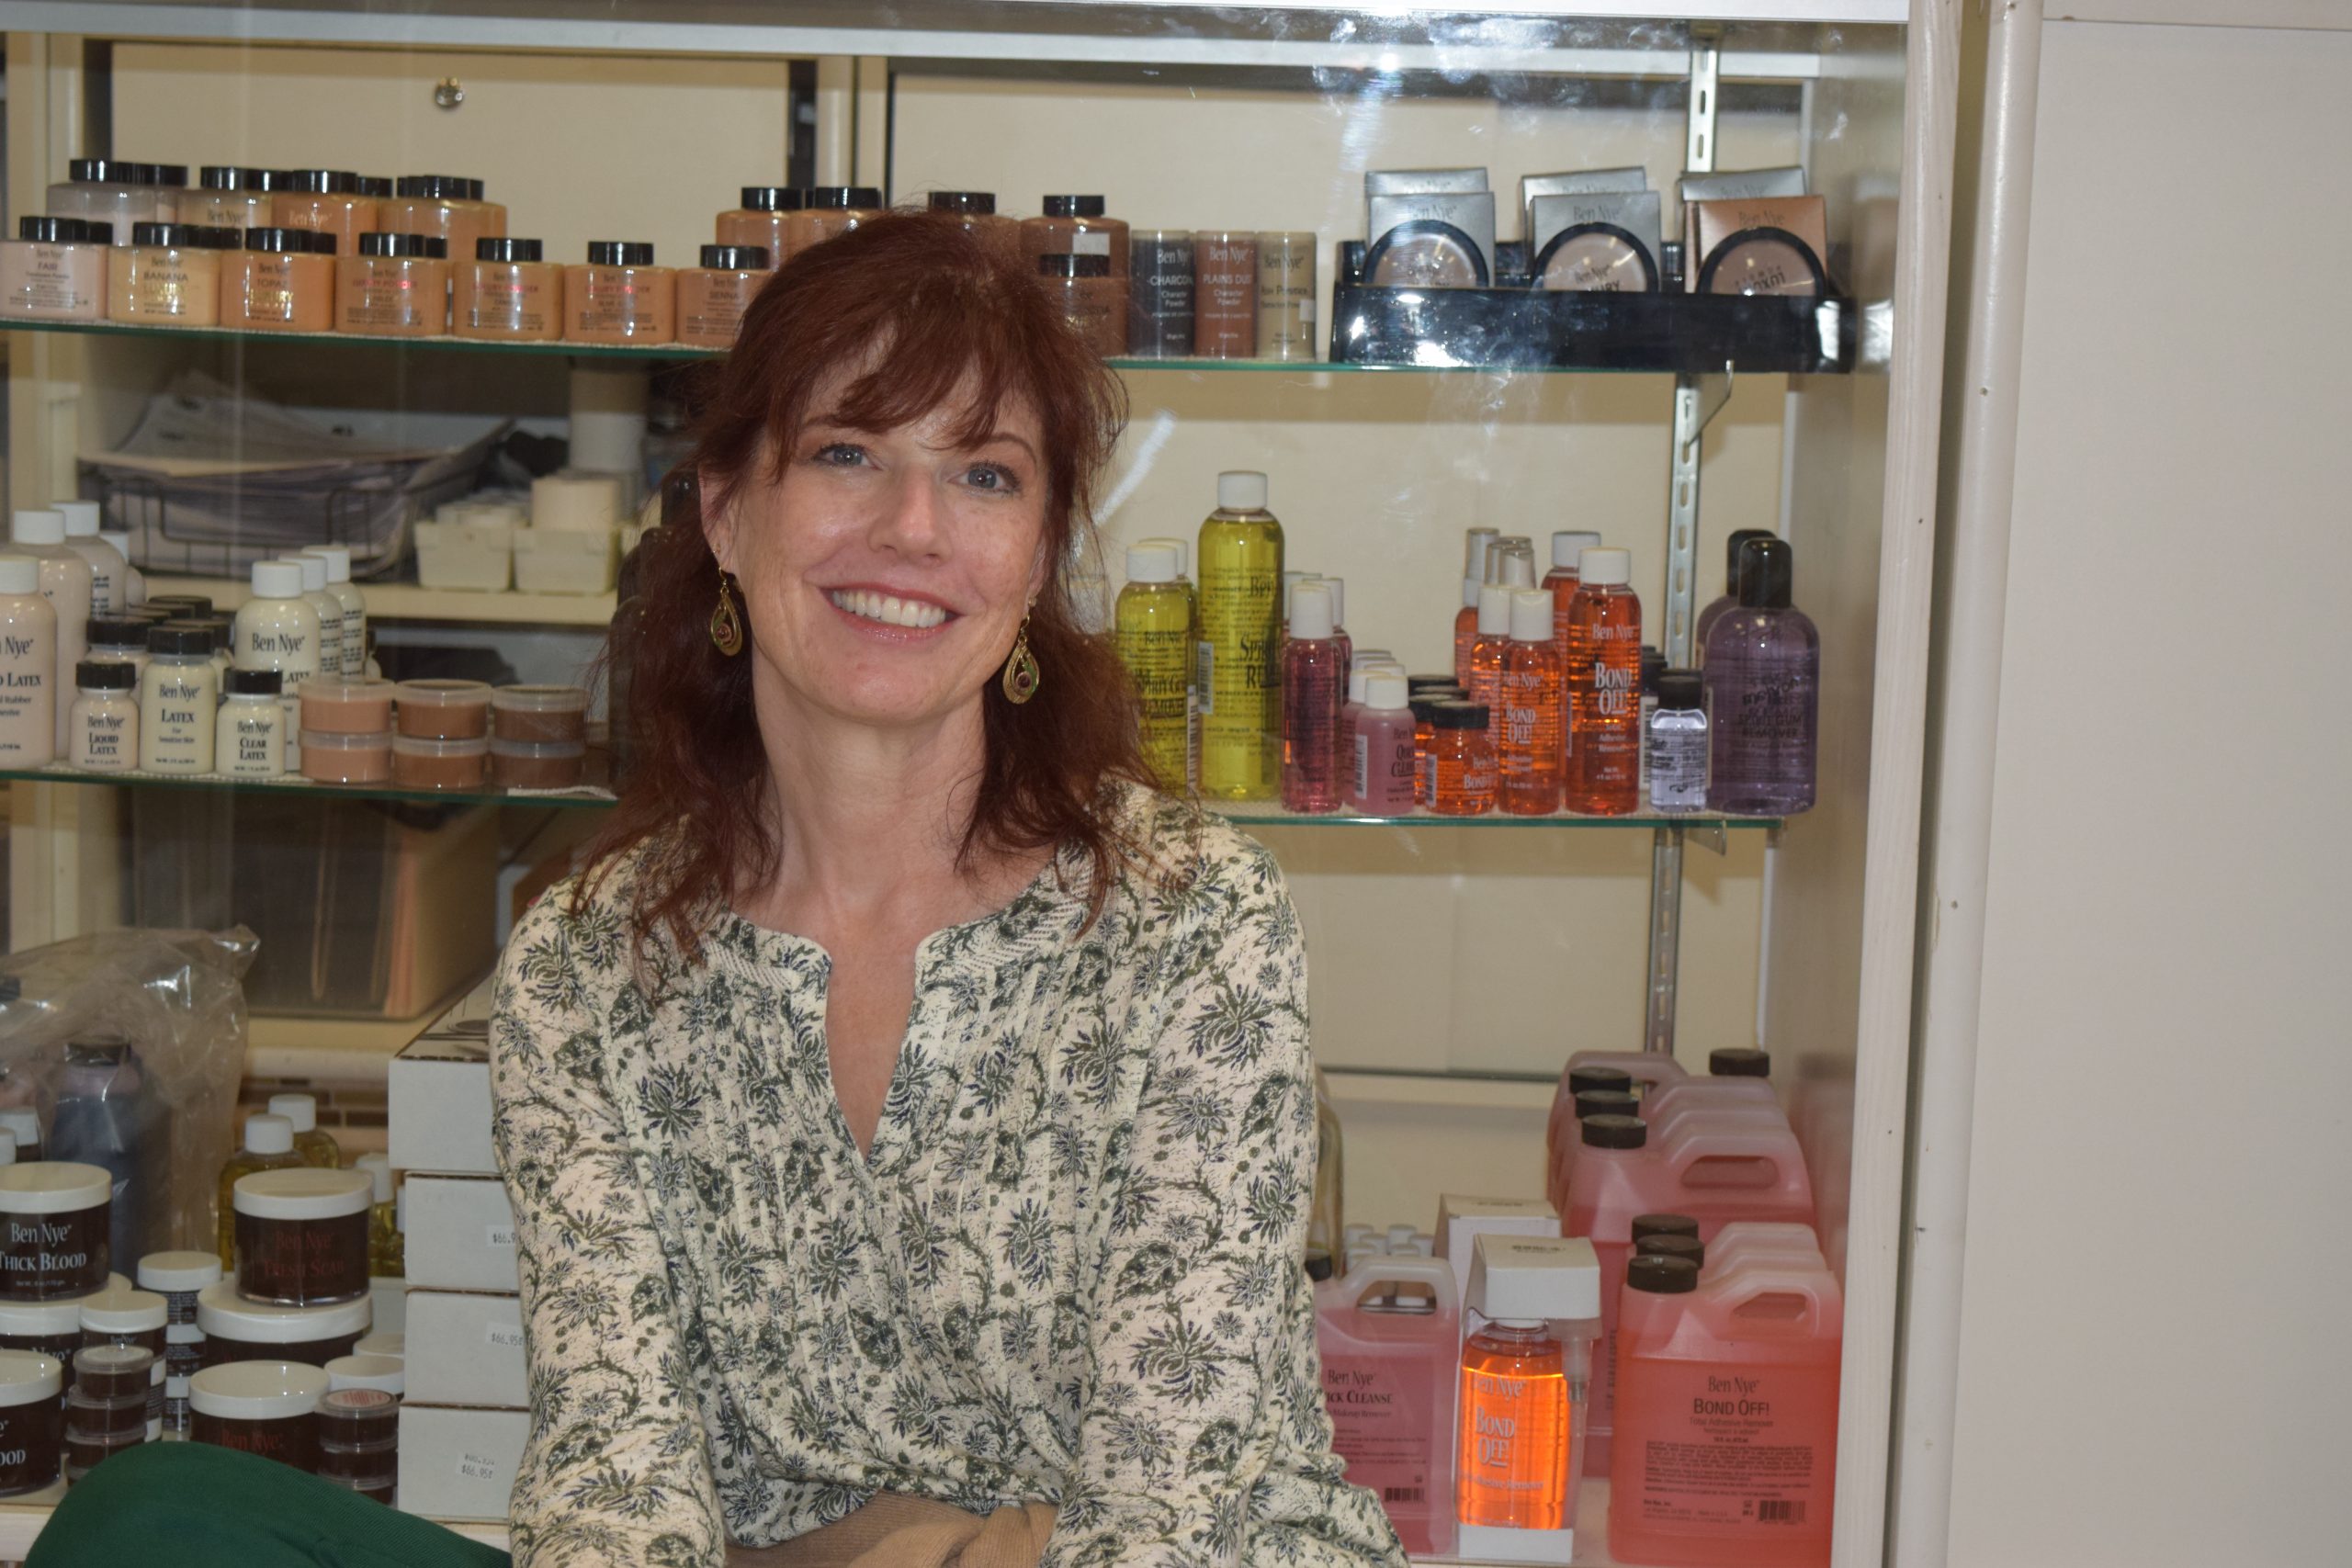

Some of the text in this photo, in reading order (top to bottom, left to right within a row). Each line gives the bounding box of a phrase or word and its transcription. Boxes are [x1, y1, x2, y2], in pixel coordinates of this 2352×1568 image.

[1573, 206, 1596, 220] Ben
[1157, 247, 1176, 265] Ben
[1209, 246, 1249, 265] Ben Nye
[1592, 623, 1634, 643] Ben Nye
[6, 635, 34, 660] Nye
[252, 632, 276, 653] Ben
[278, 632, 306, 657] Nye
[7, 672, 42, 687] LATEX
[1521, 671, 1543, 691] Nye
[1595, 661, 1633, 690] BOND
[159, 684, 200, 704] Ben Nye
[162, 708, 196, 724] LATEX
[1506, 700, 1536, 724] BOND
[87, 716, 124, 732] Ben Nye
[237, 721, 273, 738] Ben Nye
[89, 732, 119, 745] LIQUID
[239, 737, 267, 750] CLEAR
[90, 743, 118, 756] LATEX
[240, 749, 267, 761] LATEX
[11, 1223, 72, 1248] Ben Nye
[492, 1232, 515, 1245] $66.9
[0, 1250, 87, 1272] THICK BLOOD
[1328, 1369, 1374, 1390] Ben Nye
[1496, 1376, 1523, 1401] Nye
[1708, 1375, 1758, 1397] Ben Nye
[1326, 1389, 1394, 1404] ICK CLEANSE
[1693, 1397, 1770, 1416] BOND OFF!
[1476, 1405, 1516, 1439] BOND
